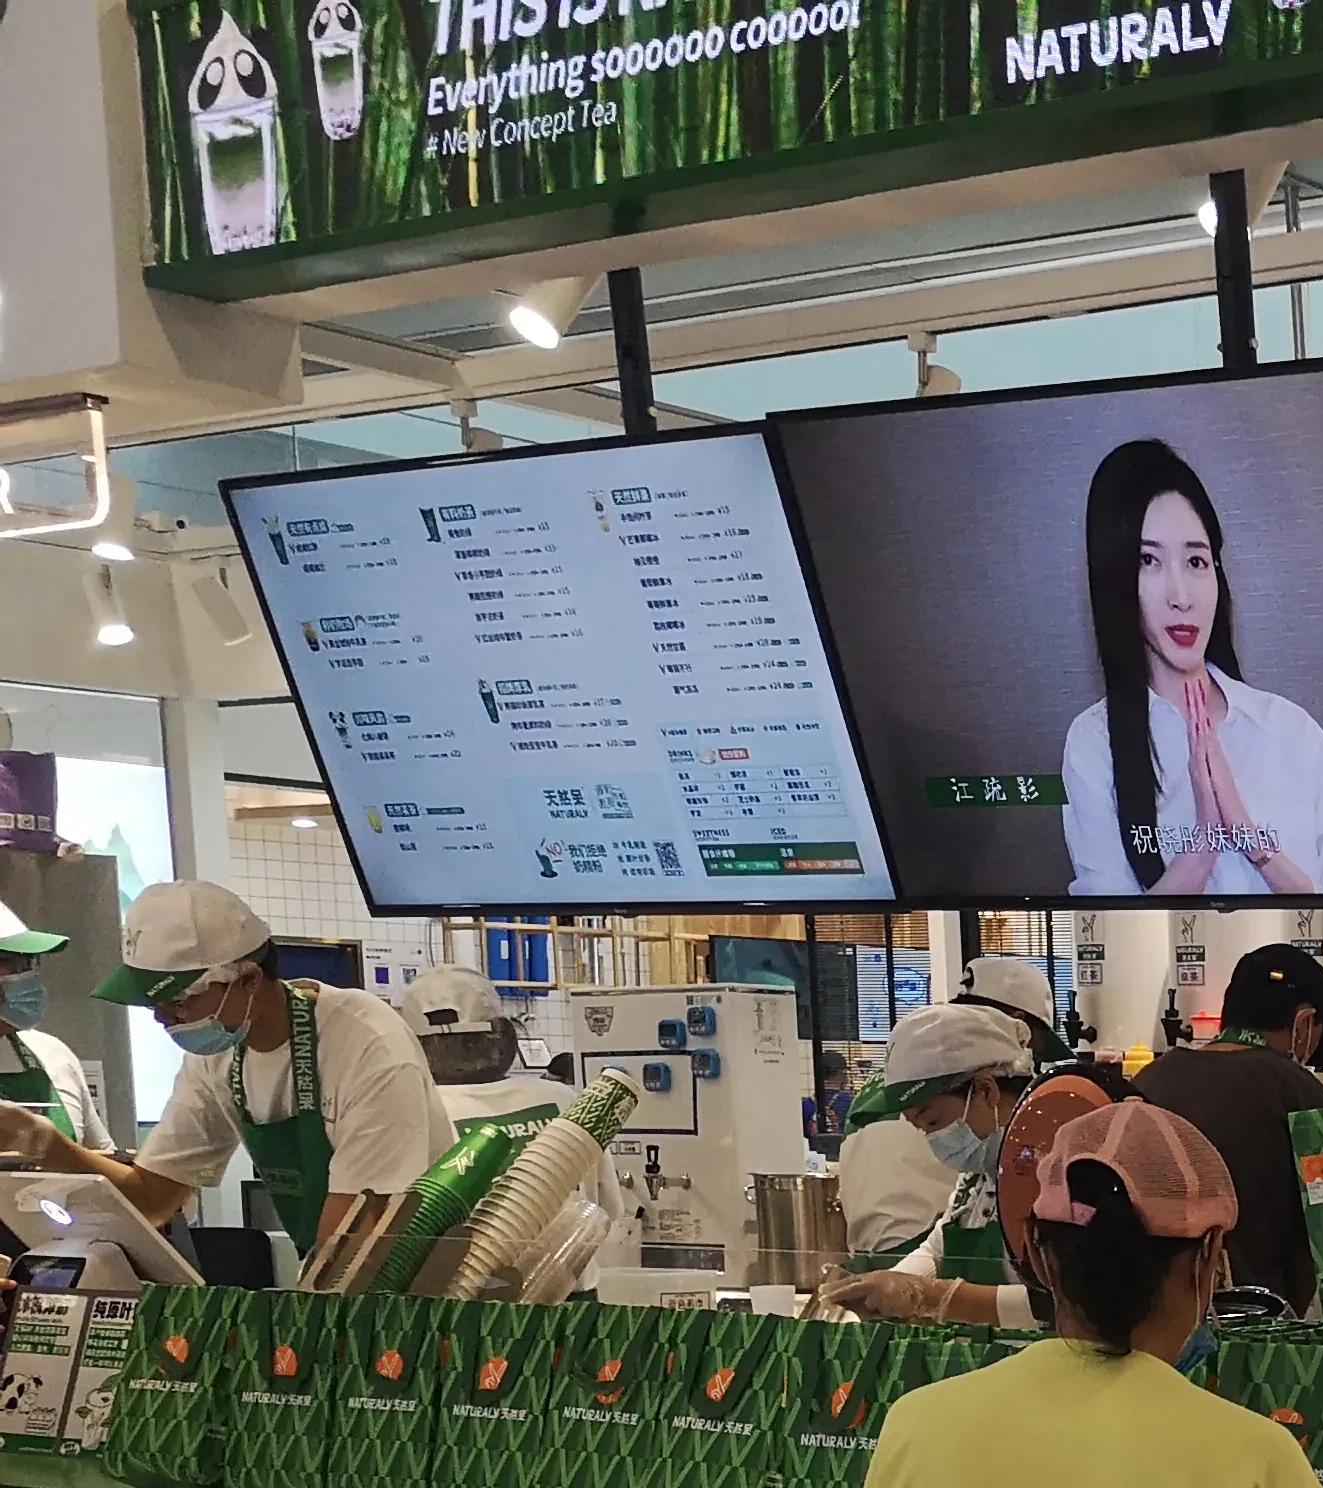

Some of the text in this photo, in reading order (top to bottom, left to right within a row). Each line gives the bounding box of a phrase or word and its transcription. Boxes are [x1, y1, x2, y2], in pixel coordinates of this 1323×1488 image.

[1005, 0, 1232, 84] NATURALV
[427, 50, 587, 116] Everything
[441, 128, 485, 156] New
[490, 108, 575, 148] Concept
[580, 99, 617, 127] Tea
[949, 776, 1041, 803] 江疏影
[562, 1405, 611, 1423] NATURALV
[671, 1415, 725, 1434] NATURALV
[800, 1432, 857, 1450] NATURALV
